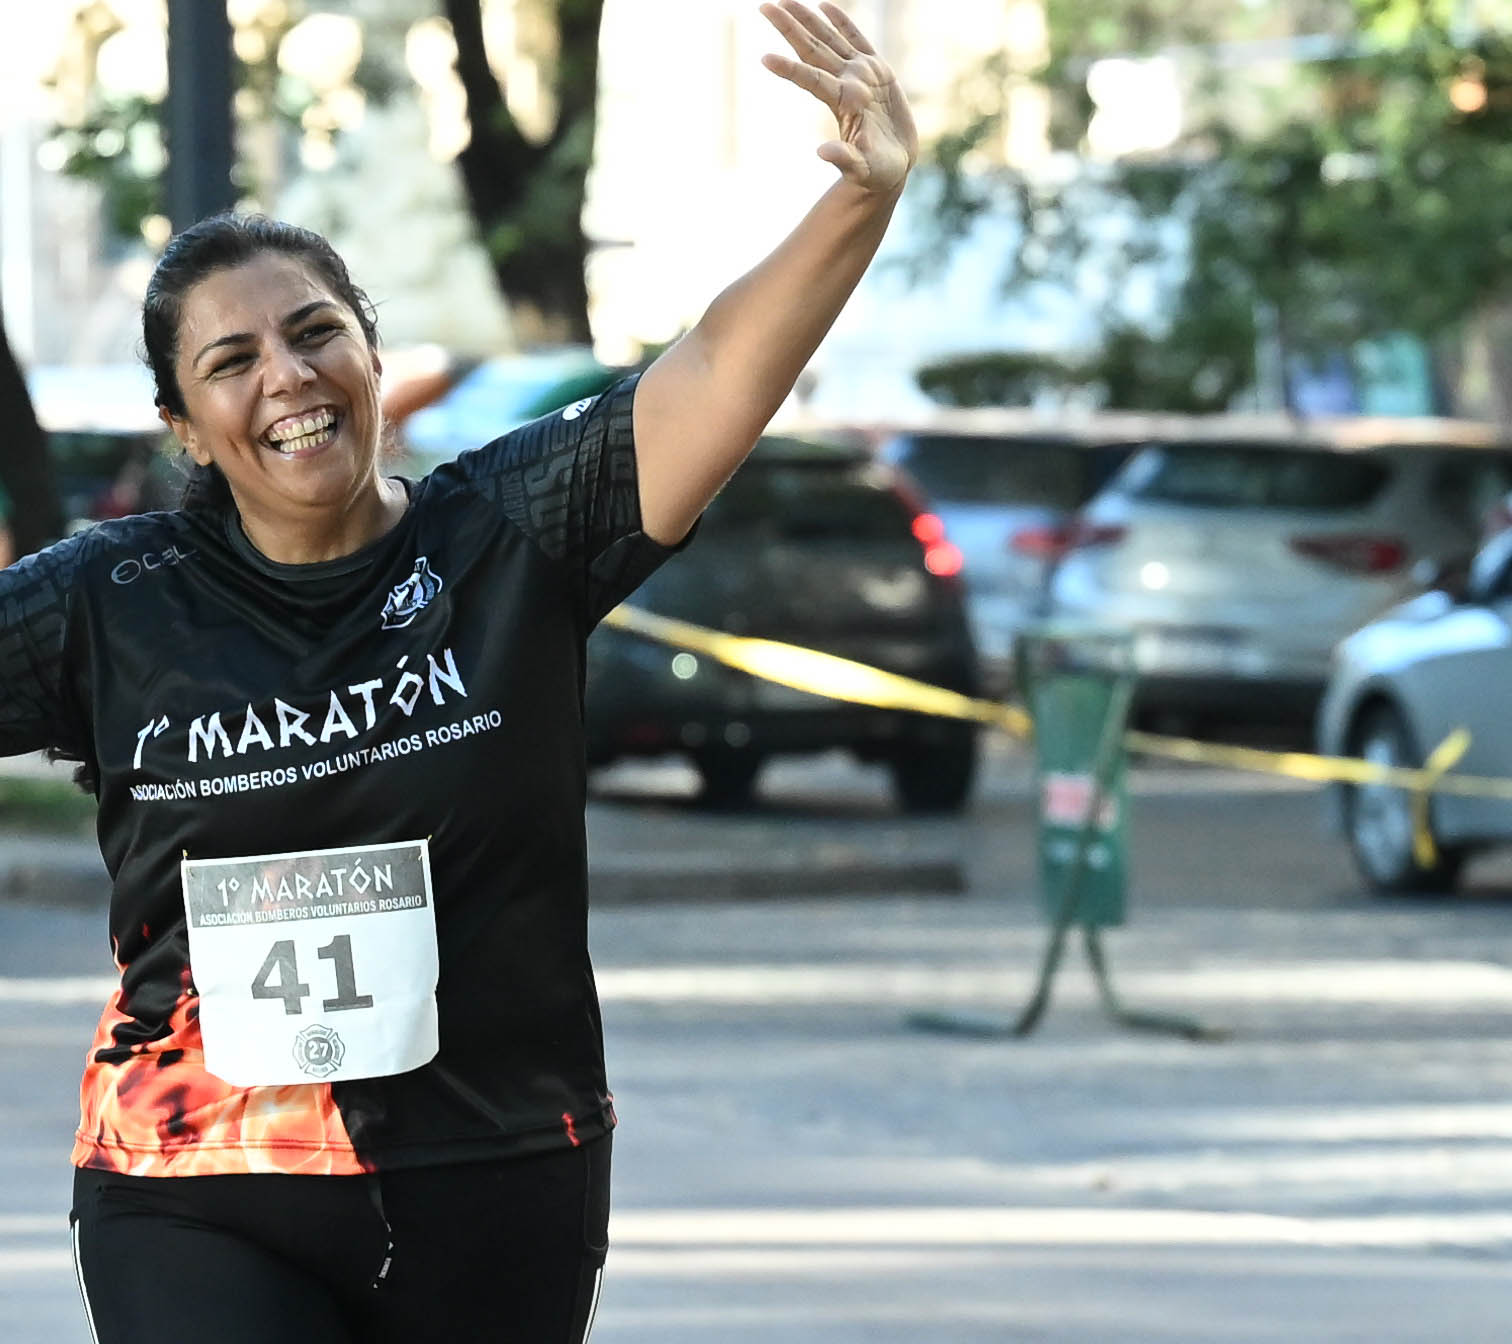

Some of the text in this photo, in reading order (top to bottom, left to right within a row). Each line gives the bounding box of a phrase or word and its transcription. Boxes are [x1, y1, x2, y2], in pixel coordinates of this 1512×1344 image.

[187, 647, 468, 763] MARATÓN
[129, 709, 502, 801] ASOCIACIÓN BOMBEROS VOLUNTARIOS ROSARIO
[251, 857, 394, 905] MARATÓN
[255, 908, 308, 923] BOMBEROS
[310, 900, 377, 918] VOLUNTARIOS
[379, 895, 422, 910] ROSARIO
[251, 934, 374, 1016] 41
[308, 1040, 330, 1060] 27
